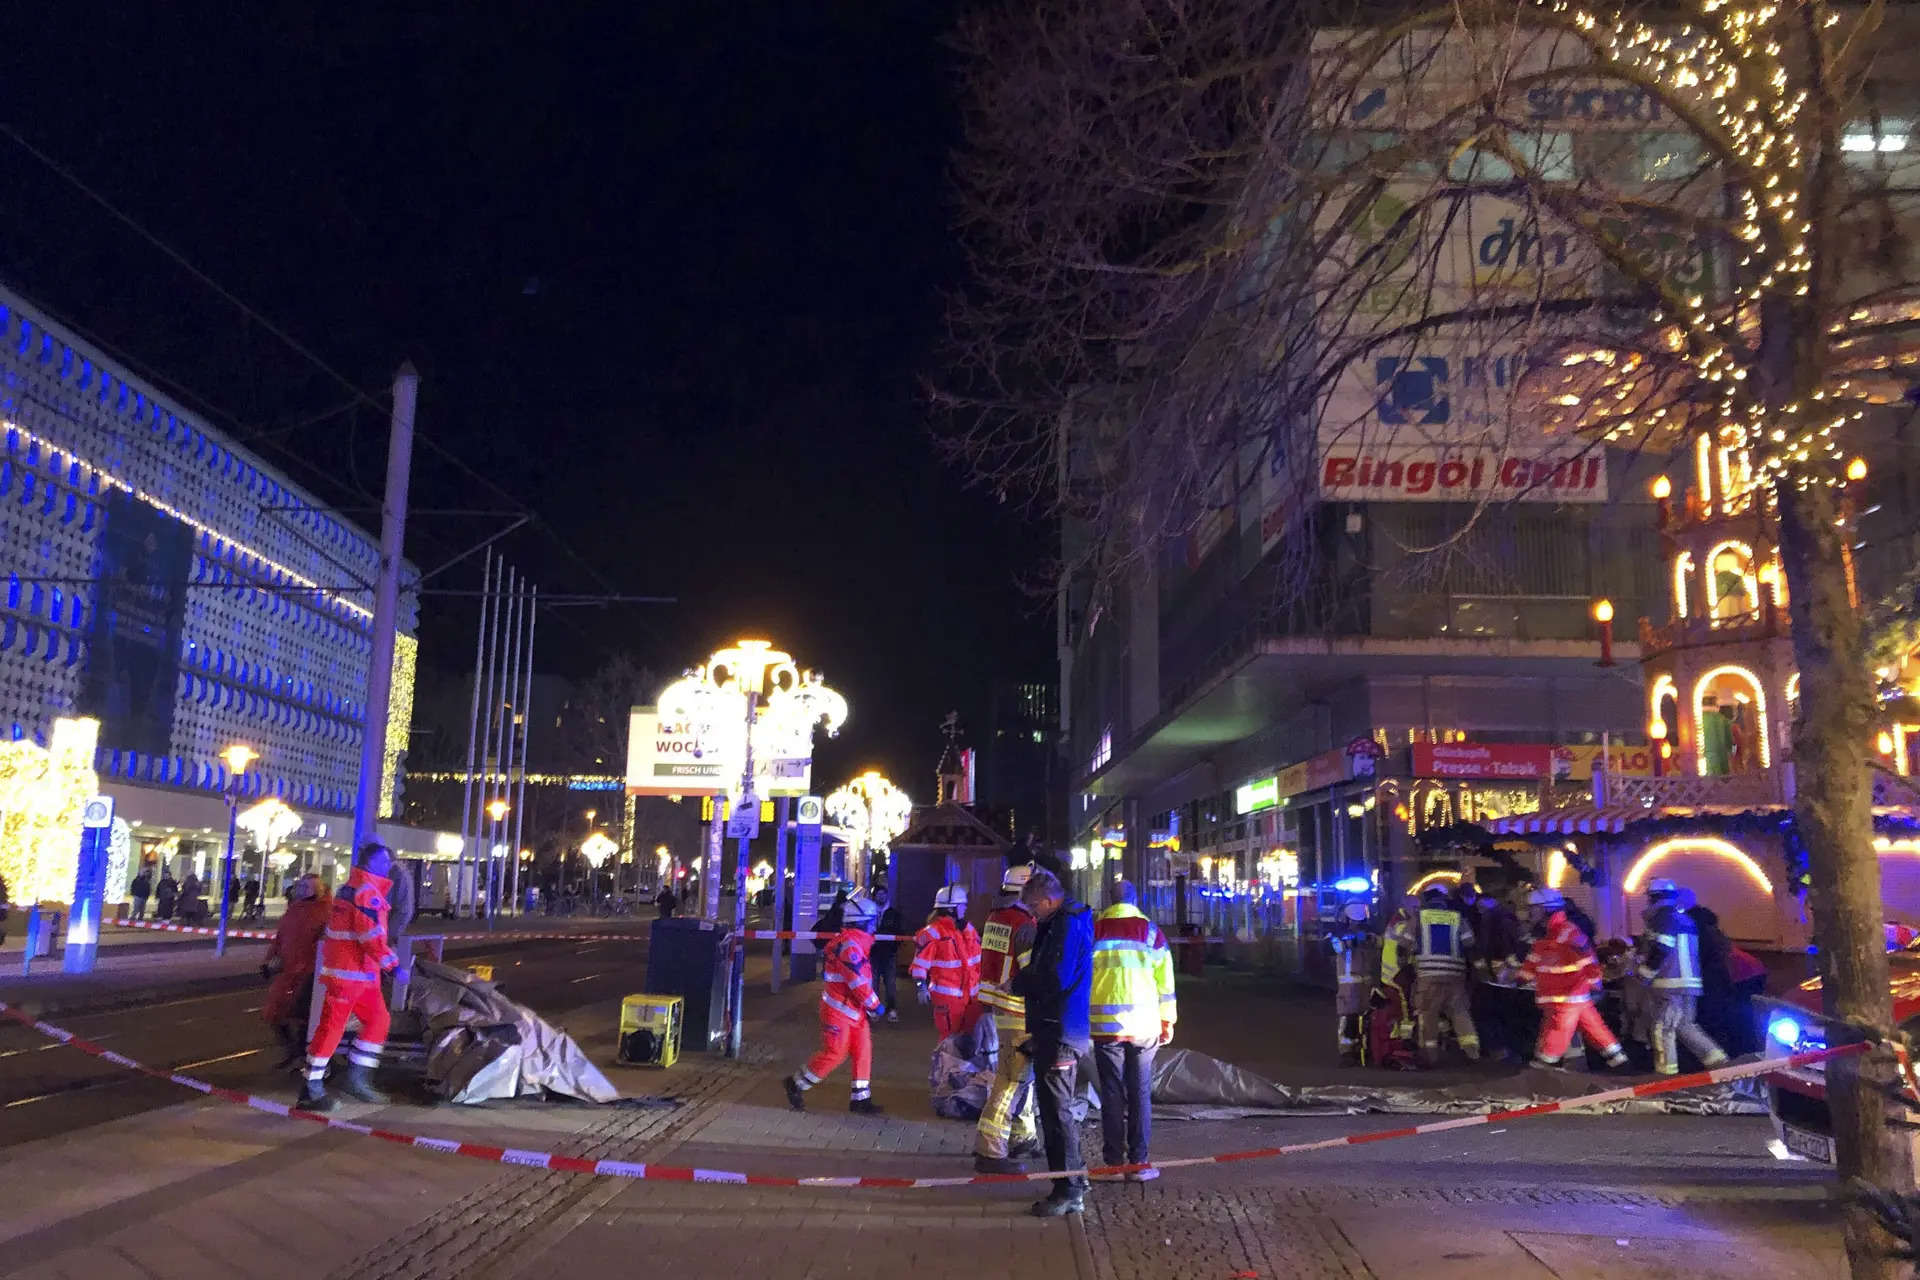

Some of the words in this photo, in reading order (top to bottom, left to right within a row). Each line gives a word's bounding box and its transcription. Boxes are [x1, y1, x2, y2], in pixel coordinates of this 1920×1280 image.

[1479, 219, 1568, 266] dm
[1323, 454, 1484, 493] Bingöl
[672, 766, 701, 775] FRISCH
[1432, 760, 1480, 774] Presse
[1491, 761, 1537, 775] Tabak
